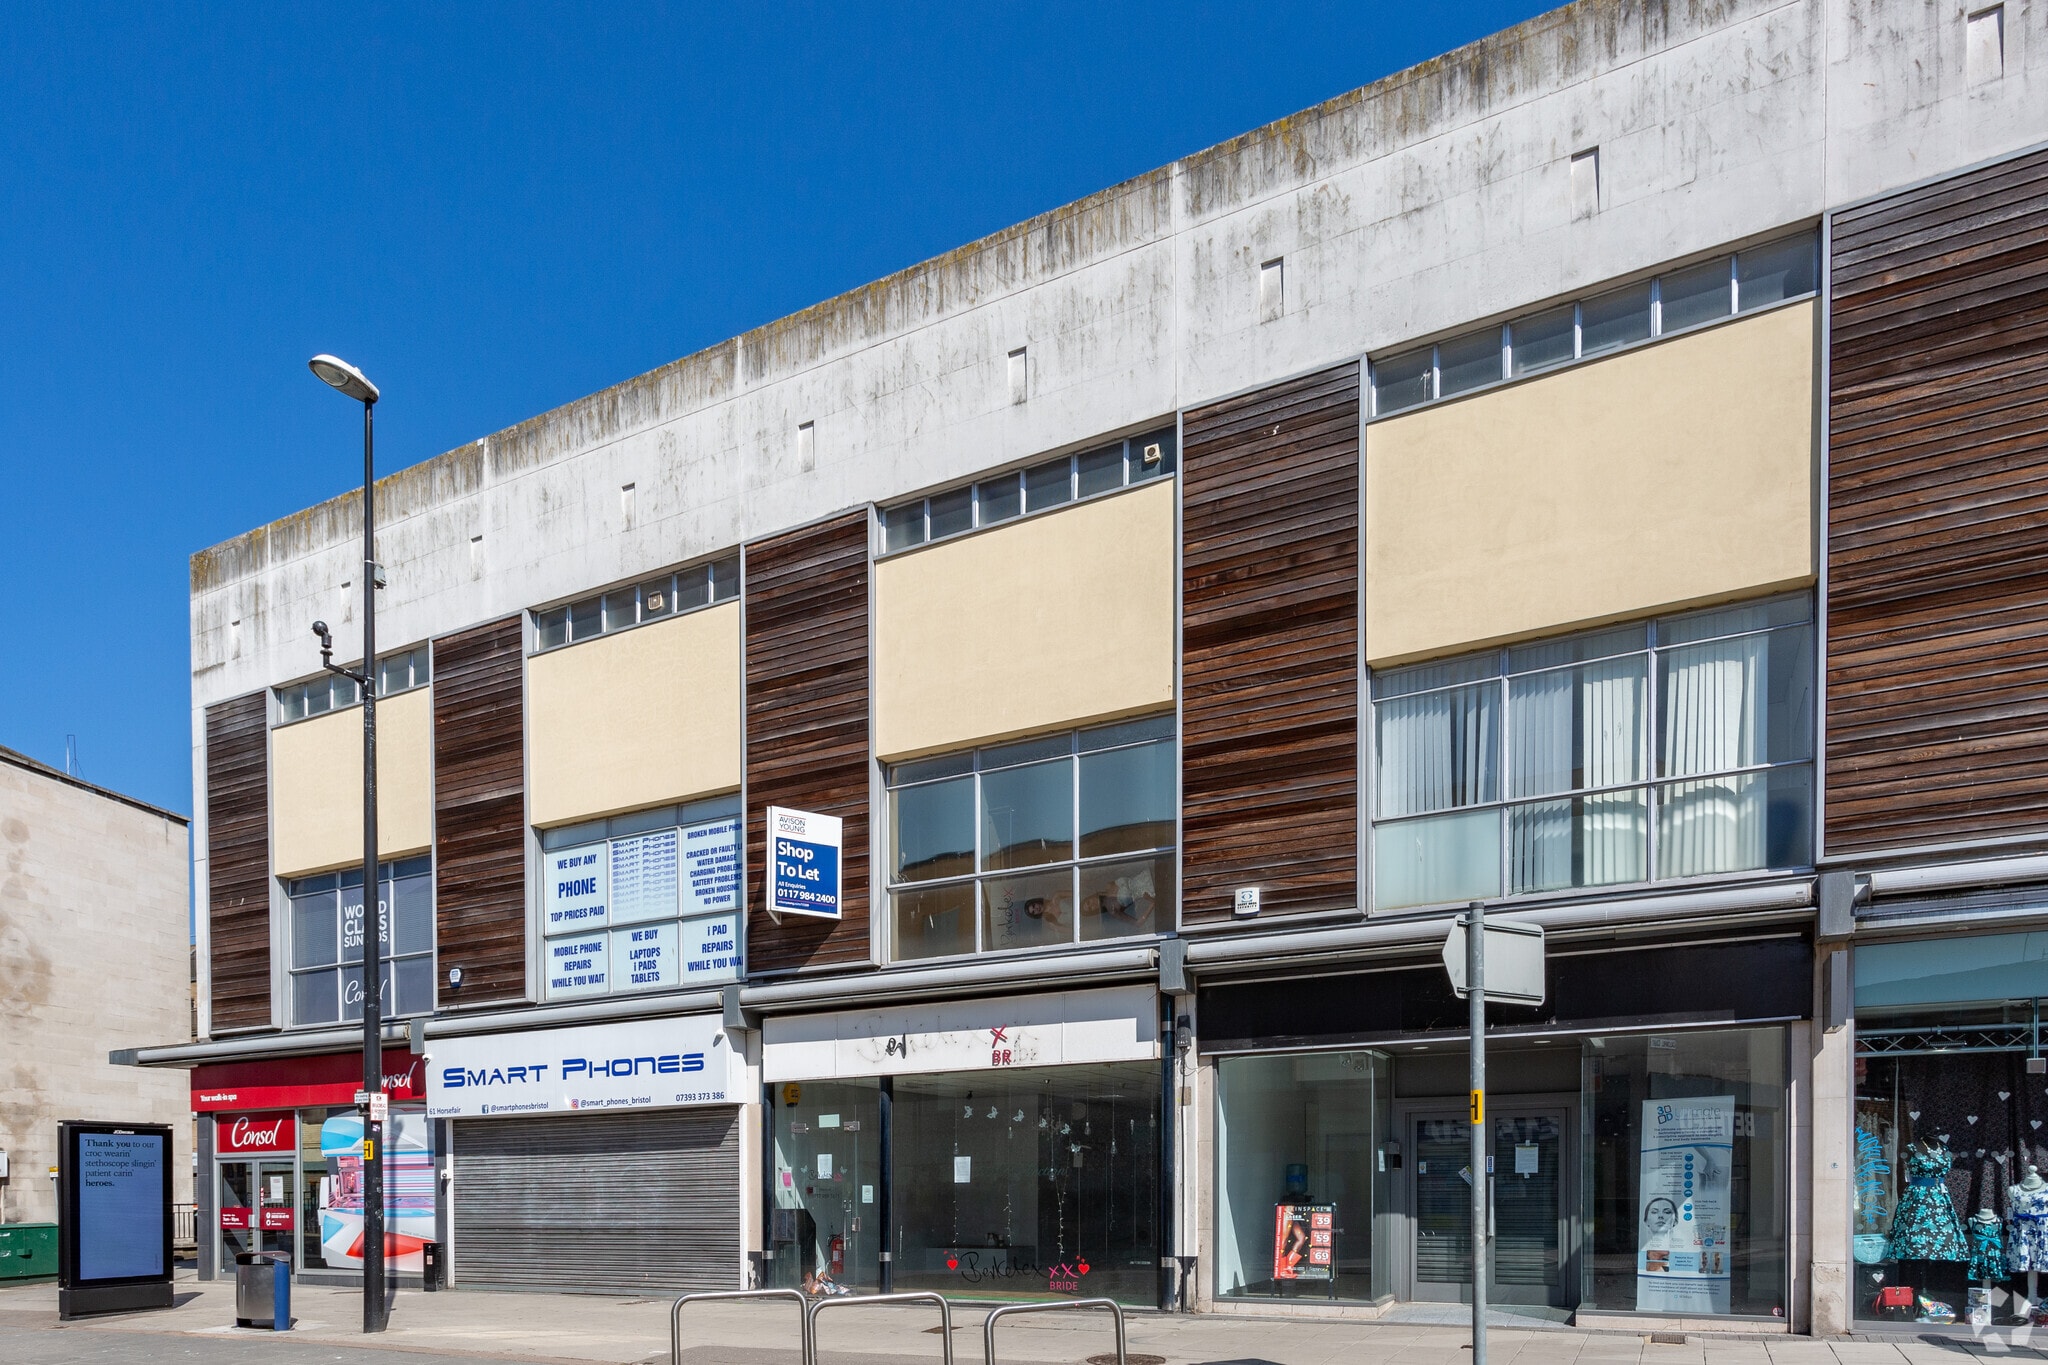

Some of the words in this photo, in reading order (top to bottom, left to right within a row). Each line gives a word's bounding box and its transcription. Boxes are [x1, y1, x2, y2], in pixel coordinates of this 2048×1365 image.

[780, 817, 805, 826] AVISON
[780, 824, 805, 833] YOUNG
[688, 828, 707, 839] BROKEN
[709, 826, 727, 835] MOBILE
[729, 824, 742, 832] PHON
[613, 840, 639, 849] SMART
[642, 833, 675, 843] PHONES
[613, 847, 639, 856] SMART
[642, 841, 675, 850] PHONES
[613, 854, 639, 863] SMART
[642, 848, 675, 858] PHONES
[686, 849, 709, 859] CRACKED
[719, 844, 736, 853] FAULTY
[778, 841, 813, 863] Shop
[558, 860, 568, 870] WE
[570, 857, 581, 868] BUY
[584, 854, 597, 865] ANY
[613, 862, 639, 870] SMART
[642, 855, 675, 865] PHONES
[697, 858, 714, 866] WATER
[715, 854, 736, 863] DAMAGE
[690, 868, 715, 878] CHARGING
[778, 862, 796, 877] To
[798, 865, 819, 881] Let
[693, 878, 713, 887] BATTERY
[715, 873, 742, 883] PROBLEMS
[785, 882, 806, 890] Enquiries
[558, 877, 596, 899] PHONE
[695, 887, 715, 896] BROKEN
[716, 884, 739, 893] HOUSING
[713, 895, 730, 903] POWER
[778, 889, 797, 899] 0117
[800, 892, 815, 901] 984
[816, 894, 836, 904] 2400
[344, 901, 387, 919] WOD
[551, 913, 562, 922] TOP
[564, 908, 588, 920] PRICES
[590, 905, 604, 916] PAID
[344, 915, 387, 935] CLS
[713, 924, 727, 935] PAD
[343, 930, 388, 947] SUNS
[632, 932, 642, 942] WE
[645, 929, 658, 940] BUY
[554, 945, 578, 957] MOBILE
[580, 942, 602, 954] PHONE
[630, 947, 660, 960] LAPTOPS
[702, 941, 733, 953] REPAIRS
[564, 959, 592, 971] REPAIRS
[639, 960, 656, 970] PADS
[688, 962, 710, 972] WHILE
[713, 958, 727, 969] YOU
[730, 956, 743, 966] WAI
[552, 978, 572, 988] WHILE
[574, 975, 586, 986] YOU
[588, 973, 605, 984] WAIT
[631, 972, 660, 983] TABLETS
[228, 1094, 237, 1102] spa
[491, 1102, 549, 1112] @smartphonesbristol
[581, 1096, 651, 1108] @smart_phones_bristol
[676, 1094, 696, 1102] 07393
[698, 1093, 710, 1101] 373
[712, 1092, 725, 1100] 386
[231, 1116, 283, 1148] Consol
[85, 1139, 114, 1147] Thank
[116, 1141, 131, 1149] you
[104, 1150, 132, 1158] wearin'
[85, 1160, 130, 1169] stethoscope
[131, 1160, 157, 1169] slingin'
[85, 1169, 112, 1178] patient
[961, 1252, 1047, 1283] Berketex
[1050, 1282, 1078, 1291] BRIDE
